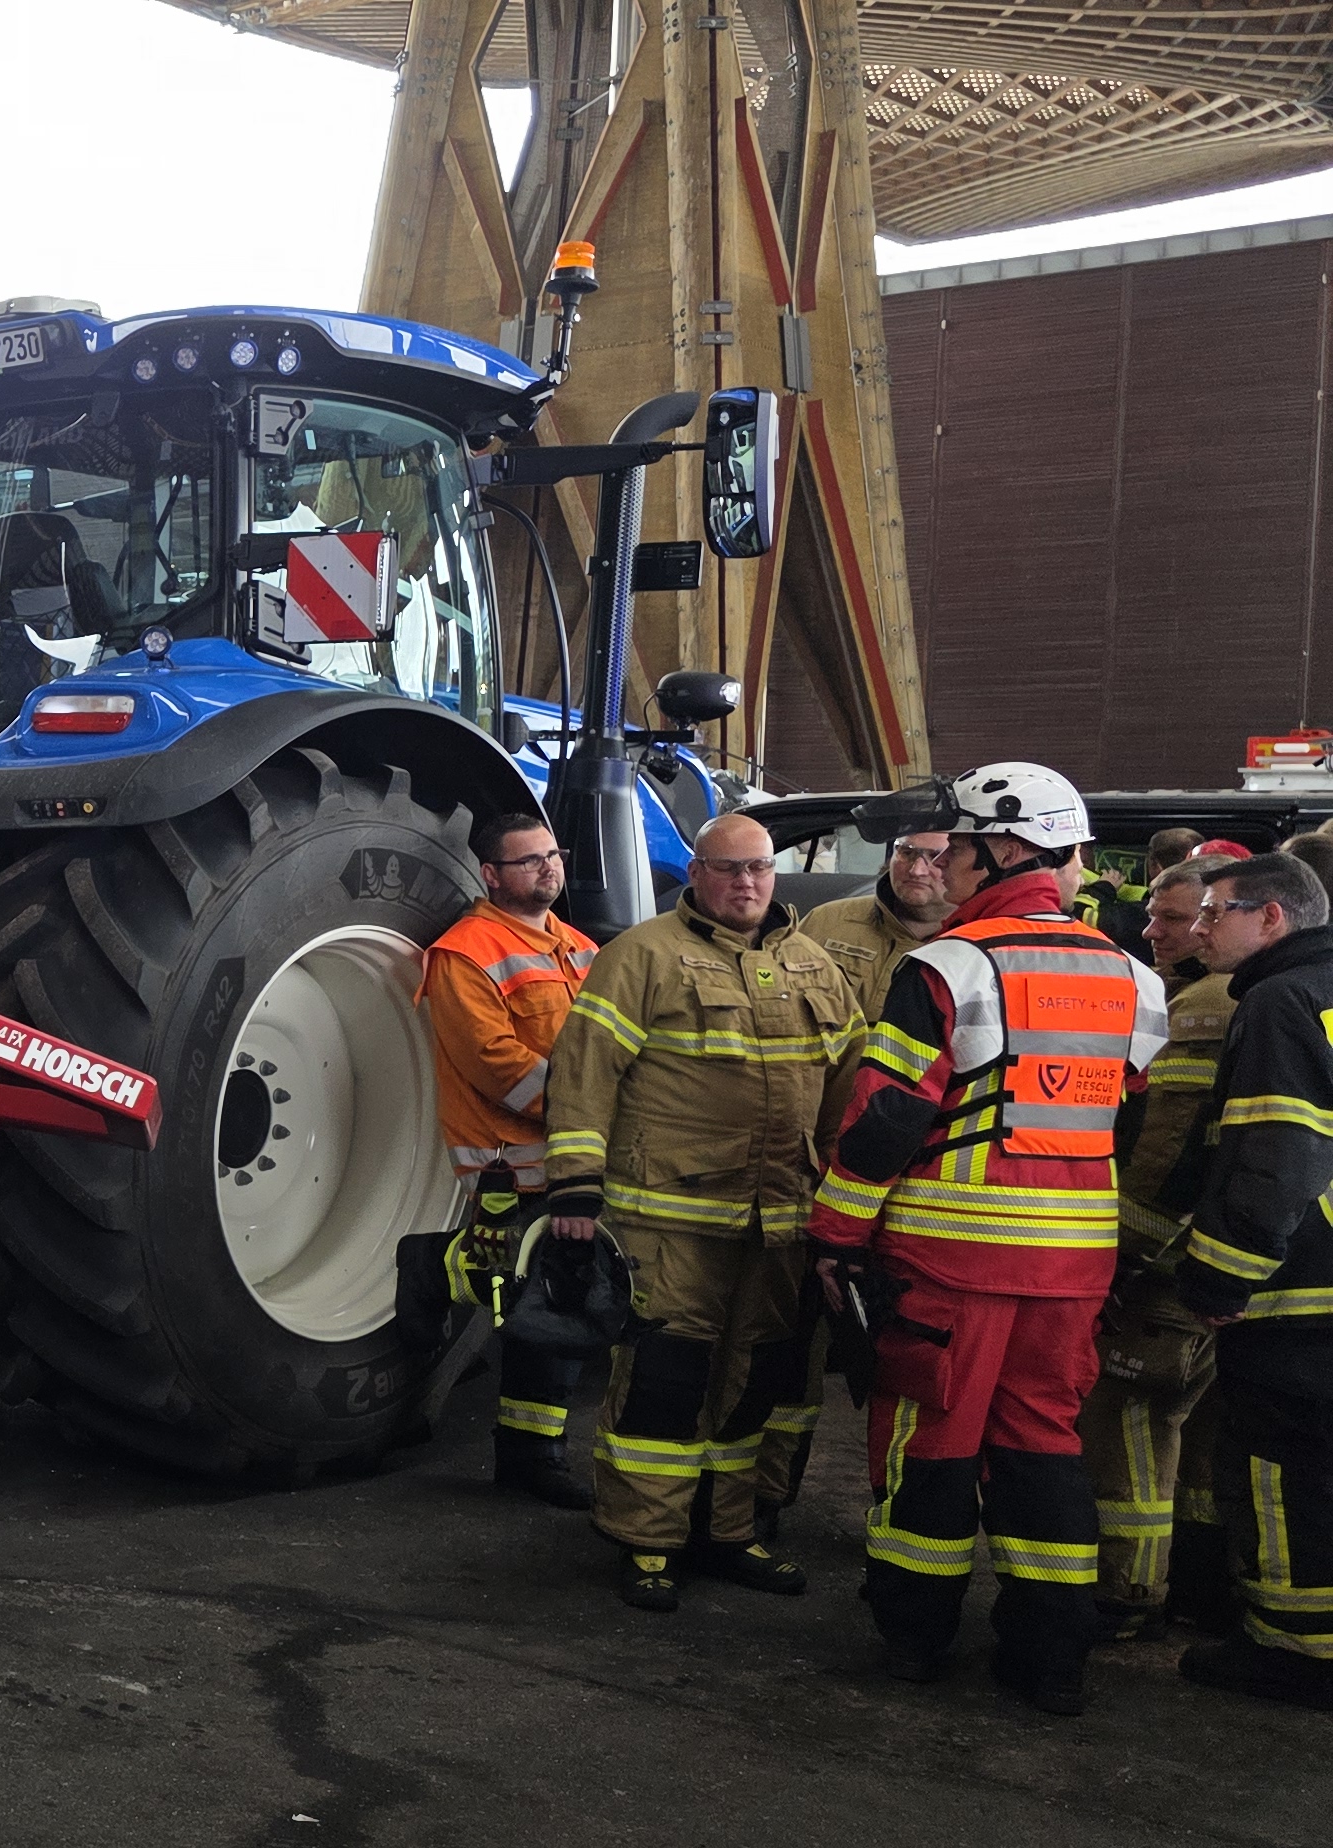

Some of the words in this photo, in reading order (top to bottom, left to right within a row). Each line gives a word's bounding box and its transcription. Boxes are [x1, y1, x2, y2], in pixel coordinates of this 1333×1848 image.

[1038, 996, 1086, 1010] SAFETY
[1100, 1000, 1126, 1012] CRM
[6, 1030, 27, 1048] FX
[20, 1037, 145, 1109] HORSCH
[1077, 1065, 1117, 1080] LUKAS
[1076, 1080, 1114, 1094] RESCUE
[1073, 1093, 1113, 1106] LEAGUE
